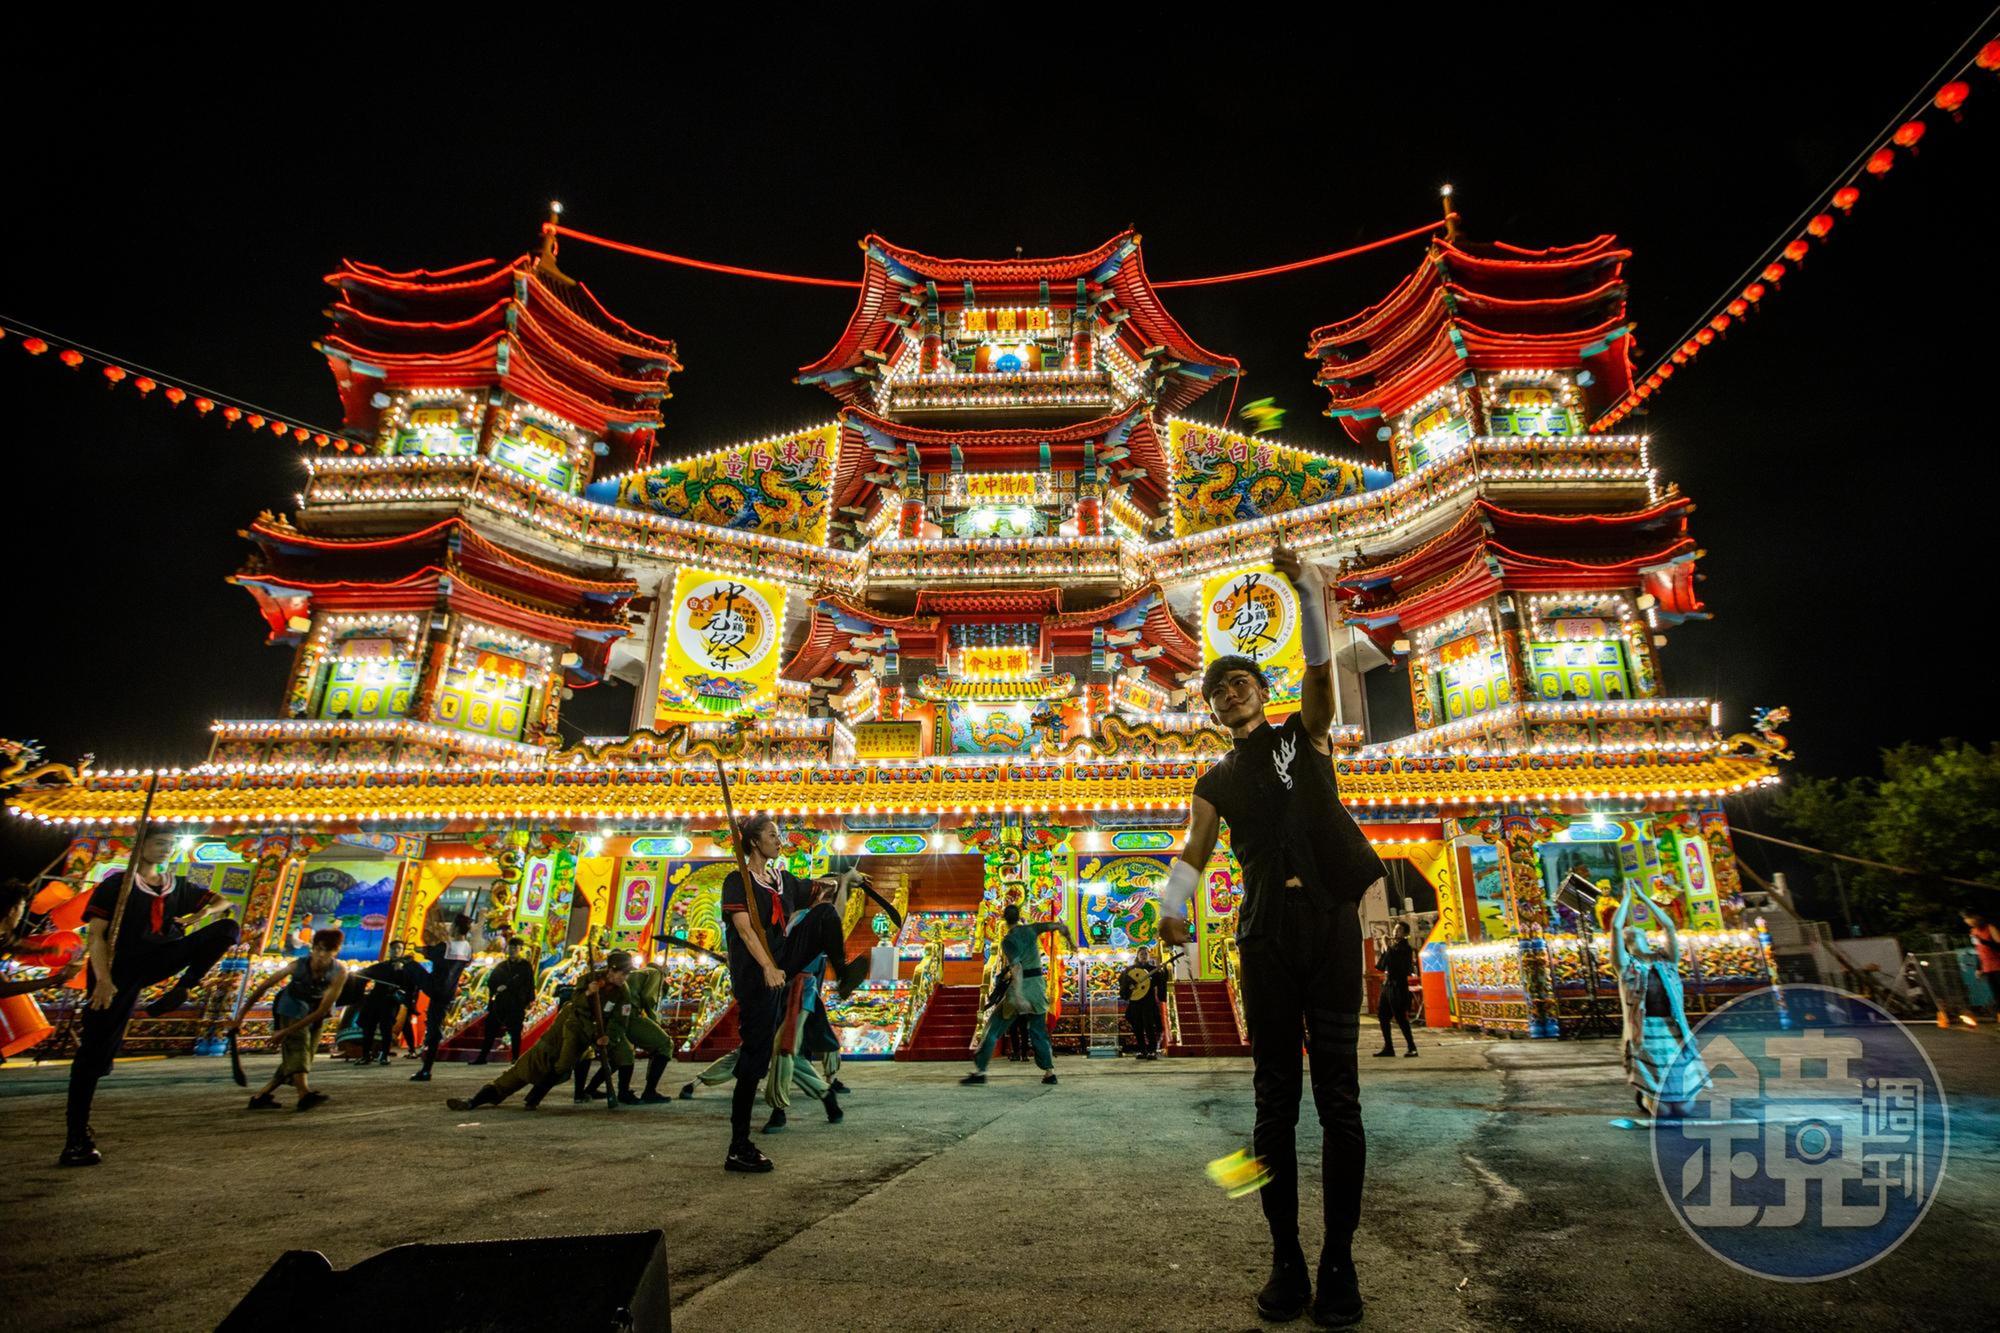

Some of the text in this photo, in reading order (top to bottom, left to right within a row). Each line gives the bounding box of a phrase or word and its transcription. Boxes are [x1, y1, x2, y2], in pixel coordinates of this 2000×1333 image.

[1254, 600, 1276, 610] 2020
[733, 615, 756, 623] 2020
[701, 582, 750, 671] 中元祭
